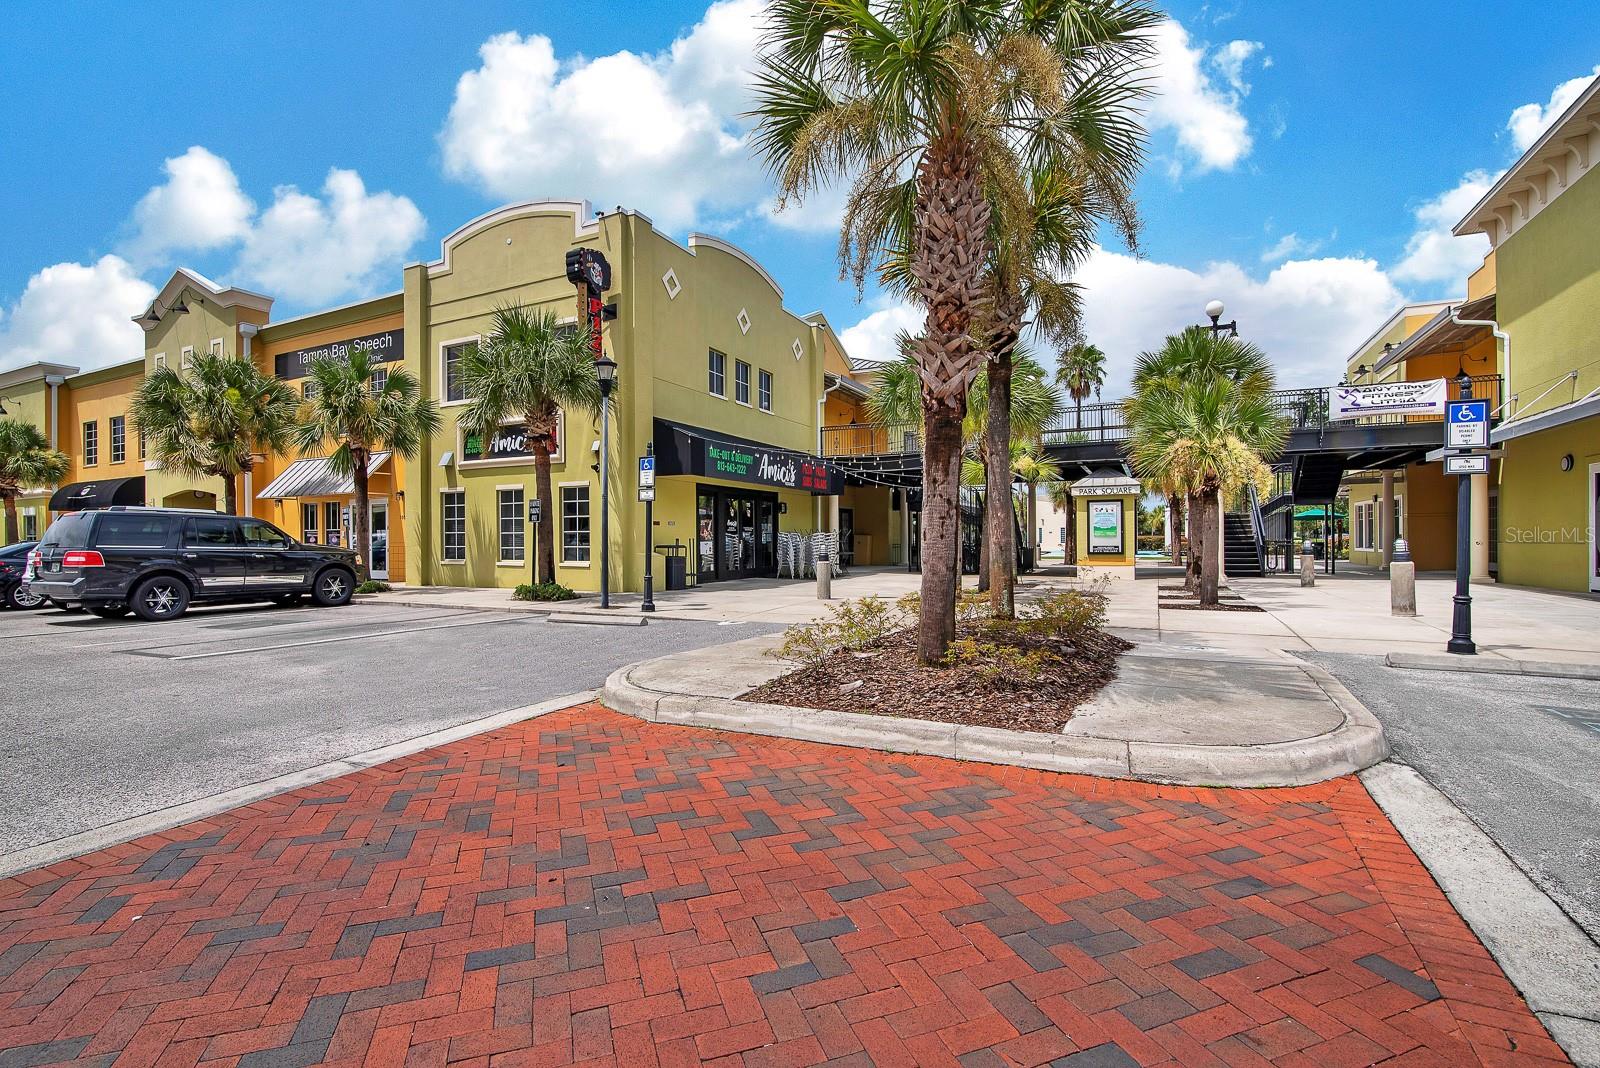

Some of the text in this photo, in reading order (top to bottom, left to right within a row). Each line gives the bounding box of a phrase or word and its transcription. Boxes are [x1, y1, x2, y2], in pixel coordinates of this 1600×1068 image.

[297, 350, 329, 364] Tampa
[331, 343, 351, 358] Bay
[353, 332, 392, 353] Speech
[1371, 397, 1417, 405] LITHIA
[717, 461, 747, 475] 813-643-1222
[1101, 486, 1133, 495] SQUARE
